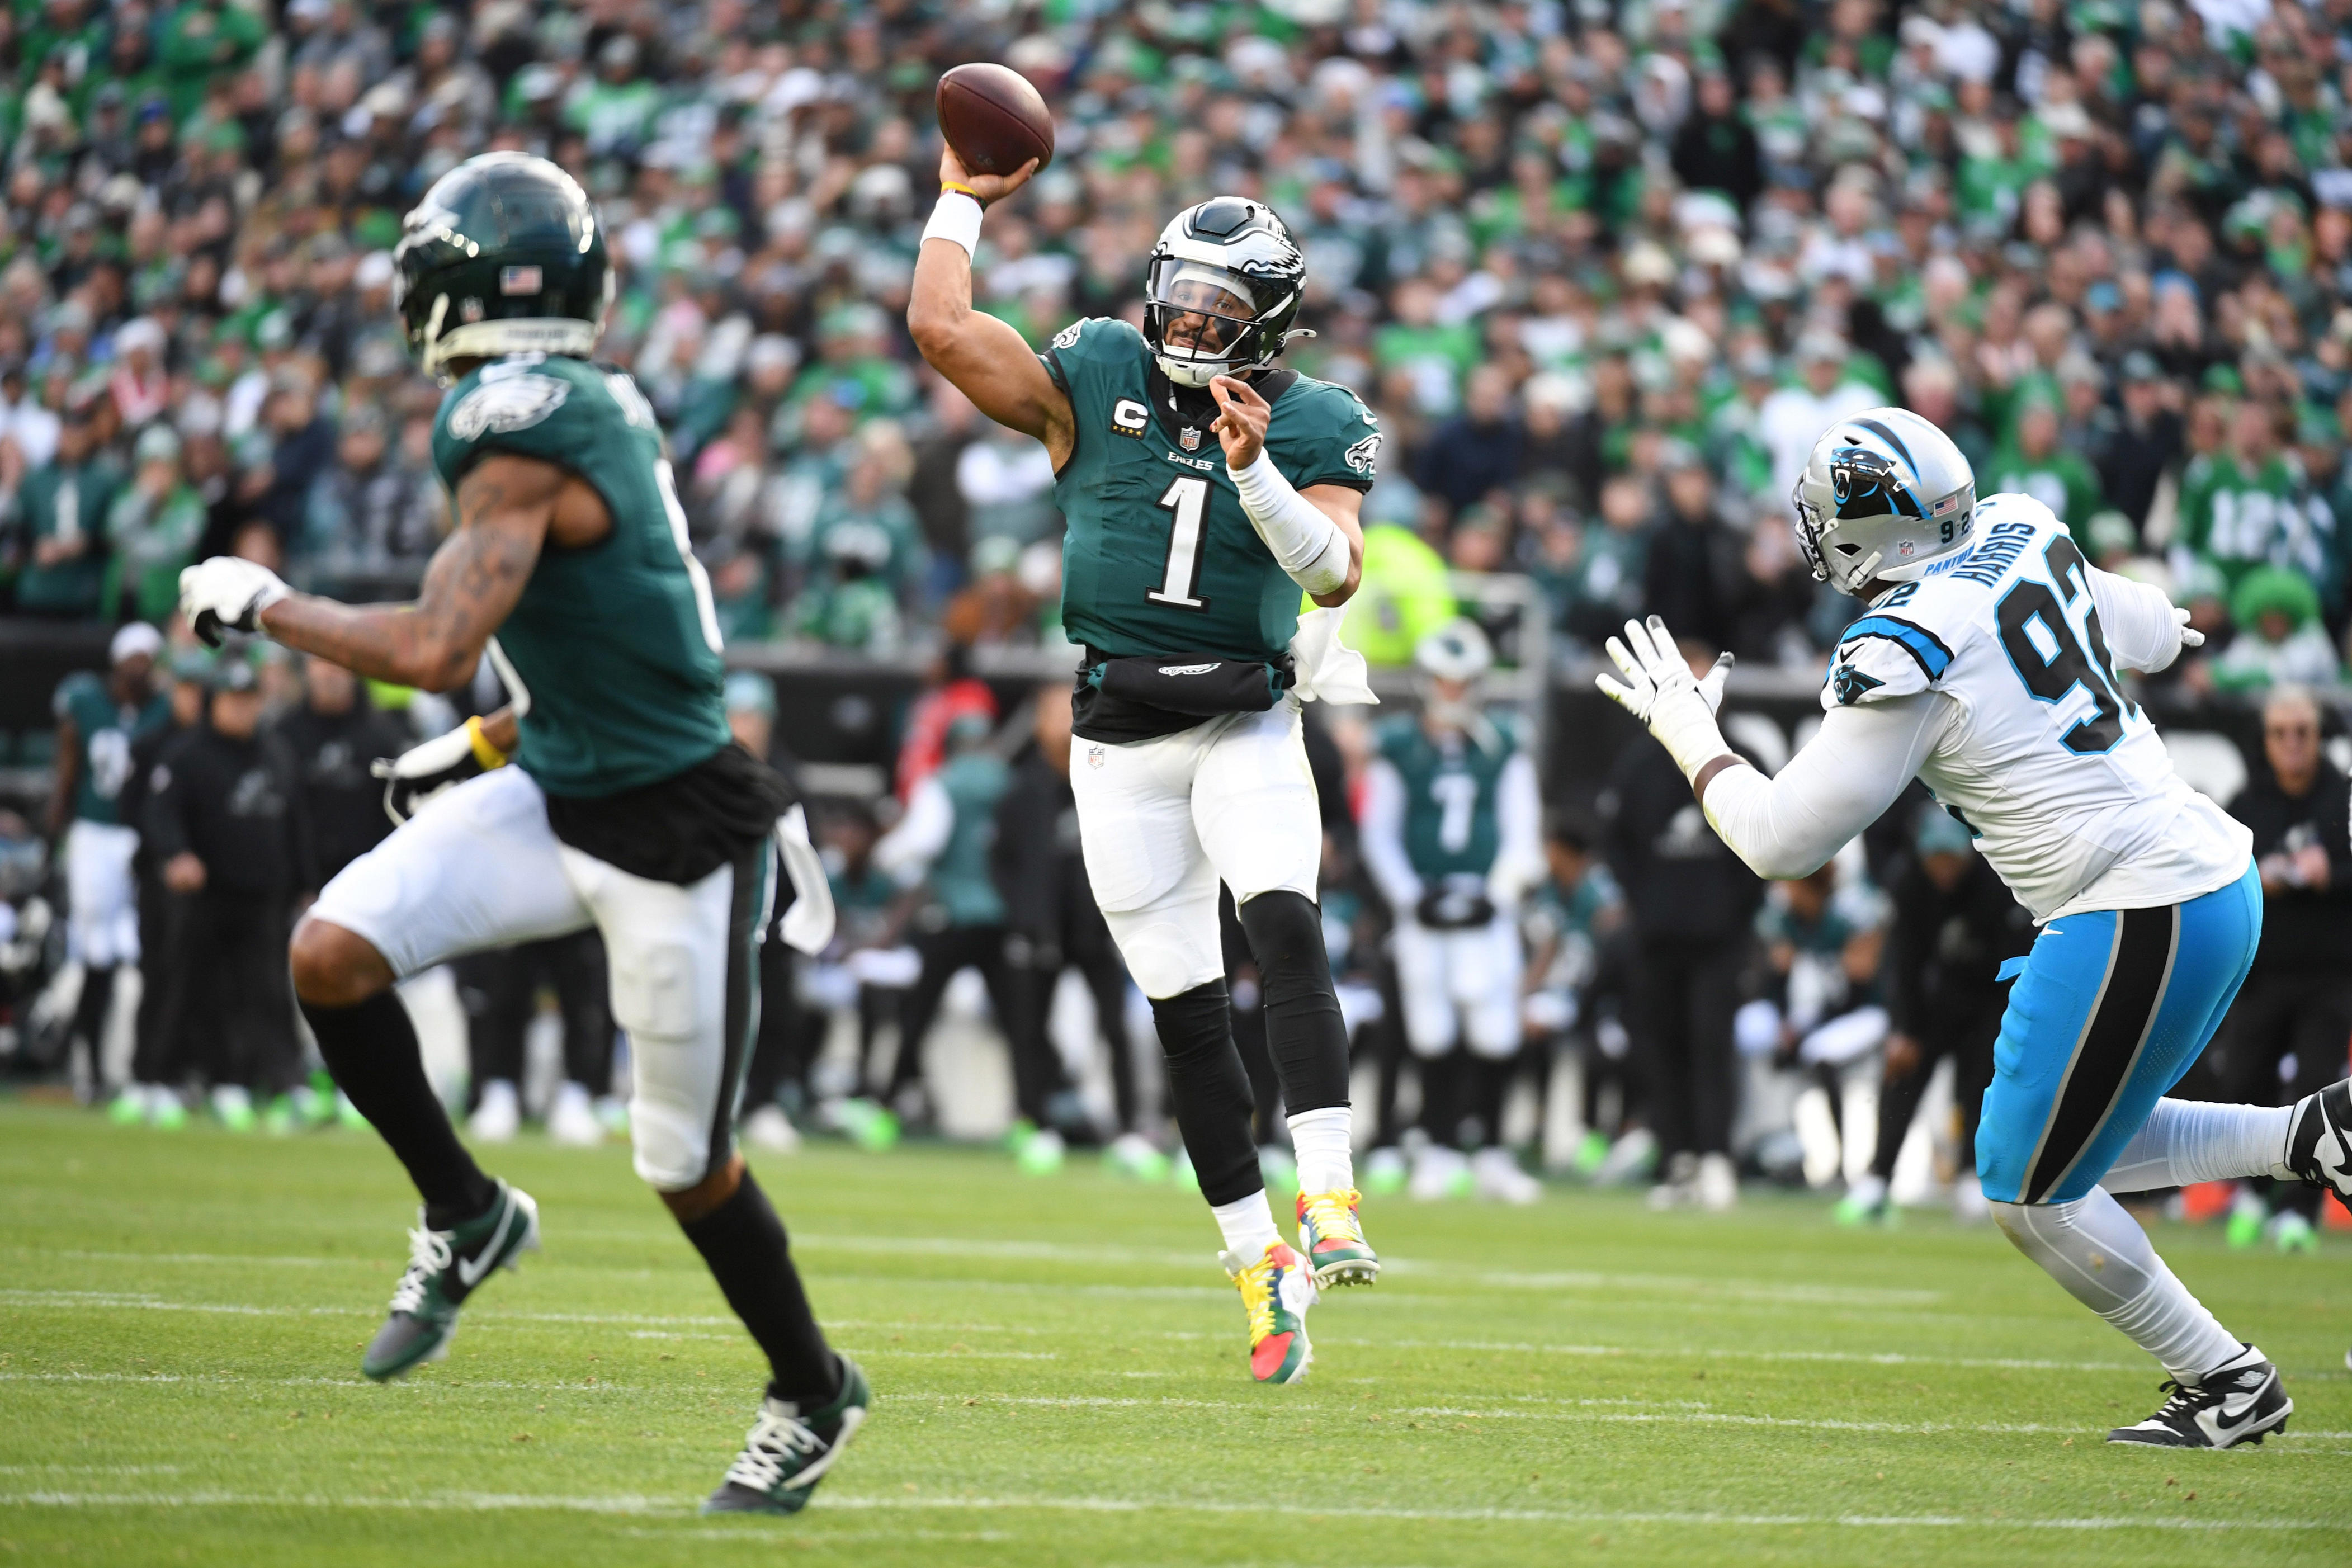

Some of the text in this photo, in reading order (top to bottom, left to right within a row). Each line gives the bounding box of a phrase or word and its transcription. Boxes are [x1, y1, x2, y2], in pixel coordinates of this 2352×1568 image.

[1114, 400, 1148, 429] C
[1183, 437, 1196, 447] NFL
[1167, 451, 1215, 471] EAGLES
[1146, 474, 1211, 611] 1
[1900, 547, 1913, 555] NFL
[1949, 523, 2037, 589] HARRIS
[1995, 532, 2139, 756] 92
